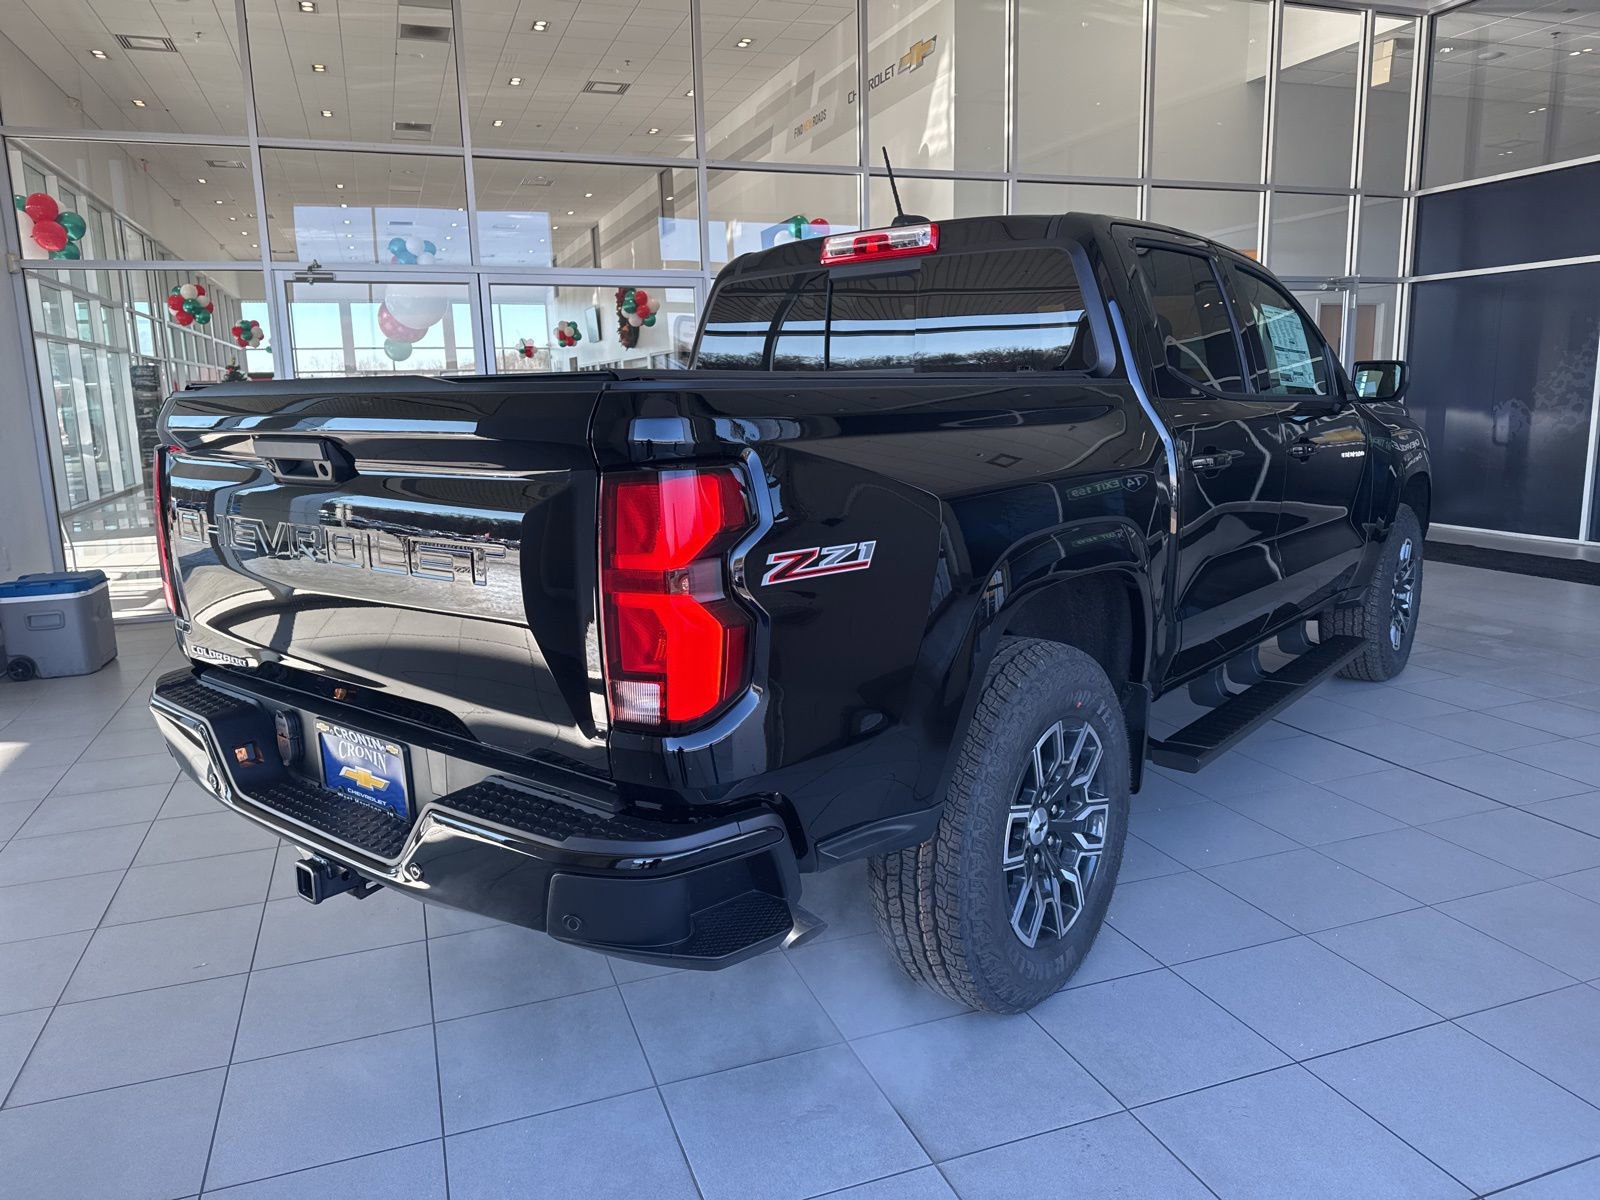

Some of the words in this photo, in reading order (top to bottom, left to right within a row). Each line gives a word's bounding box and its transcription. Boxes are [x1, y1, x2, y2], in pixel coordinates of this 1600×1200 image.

[847, 64, 895, 105] CHROLET
[794, 124, 804, 139] FIND
[812, 109, 827, 127] ROADS
[178, 508, 508, 586] CHEVROLET
[761, 540, 876, 586] Z71
[191, 645, 247, 667] COLORADO
[333, 726, 384, 751] CRONIN
[338, 740, 388, 775] CRONIN
[347, 787, 387, 806] CHEVROLET
